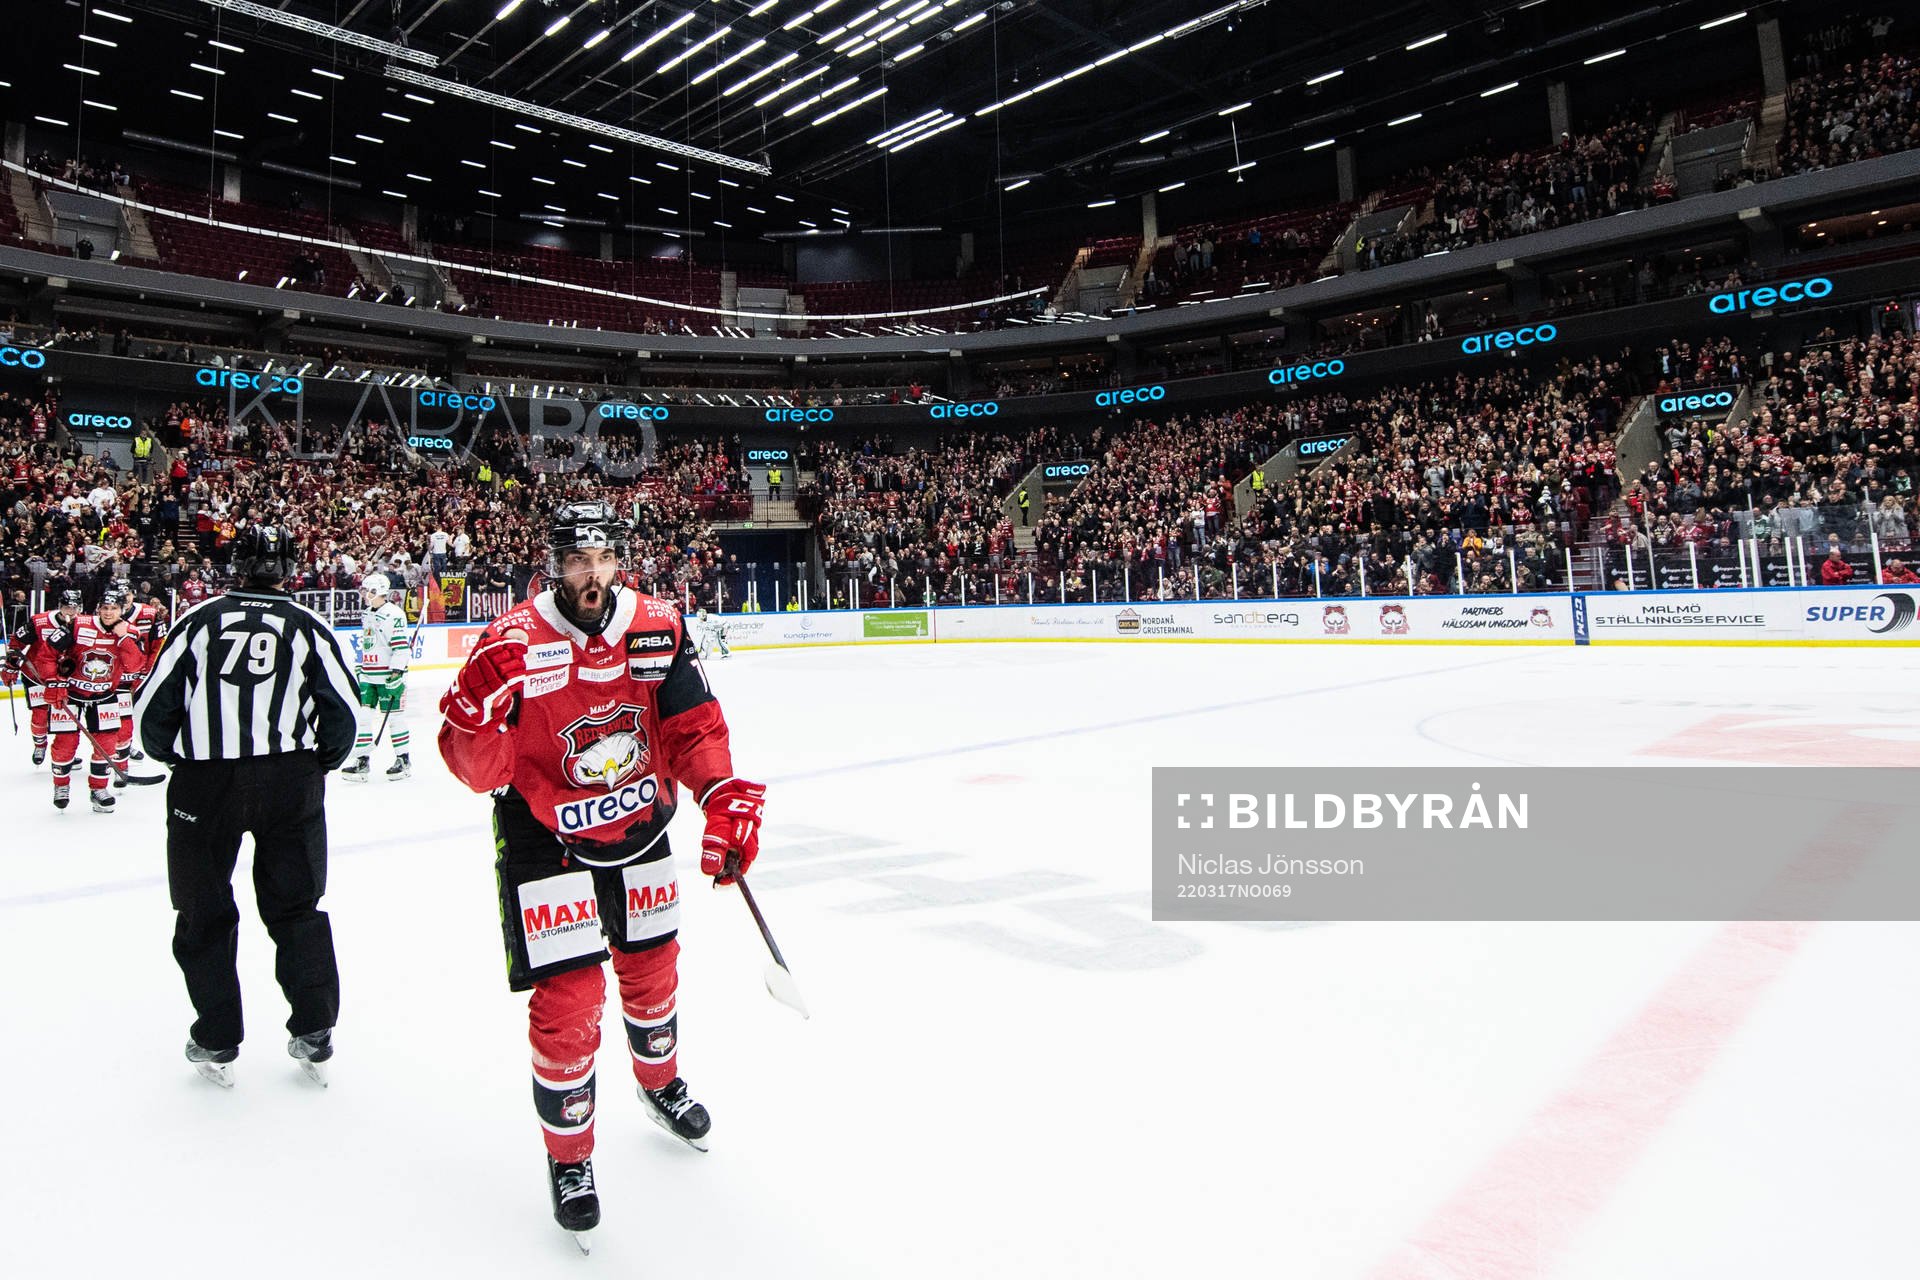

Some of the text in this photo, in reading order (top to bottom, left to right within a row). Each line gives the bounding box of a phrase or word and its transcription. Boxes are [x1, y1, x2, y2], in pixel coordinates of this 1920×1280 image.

[1709, 277, 1833, 313] areco
[1461, 324, 1557, 353] areco
[1268, 359, 1345, 385] areco
[418, 390, 496, 411] areco
[1095, 385, 1165, 407] areco
[1661, 391, 1733, 412] areco
[598, 403, 669, 420] areco
[765, 406, 834, 422] areco
[929, 402, 998, 420] areco
[68, 412, 132, 429] areco
[407, 436, 453, 449] areco
[748, 449, 788, 460] areco
[1045, 464, 1090, 477] areco
[440, 569, 467, 578] MALMÖ
[239, 601, 273, 609] CCM
[1461, 607, 1504, 616] PARTNERS
[1642, 603, 1701, 614] MALMÖ
[492, 608, 530, 628] MALMÖ
[1142, 613, 1175, 625] NORDANÅ
[1213, 611, 1299, 626] sandberg
[1574, 598, 1588, 636] CCM
[1595, 614, 1766, 625] STÄLLNINGSSERVICE
[1806, 606, 1886, 622] SUPER
[496, 616, 533, 633] ARENA
[1142, 626, 1194, 634] GRUSTERMINAL
[1442, 618, 1529, 629] HÄLSOSAM UNGDOM
[639, 636, 673, 648] RSA
[783, 631, 833, 641] Kundpartner
[536, 648, 570, 660] TREANO
[529, 671, 566, 687] Prioritet
[575, 712, 634, 750] REDHAWKS
[561, 779, 657, 830] areco
[523, 899, 597, 934] MAXI
[540, 920, 599, 939] STORMARKNAD
[646, 1002, 670, 1015] CCM
